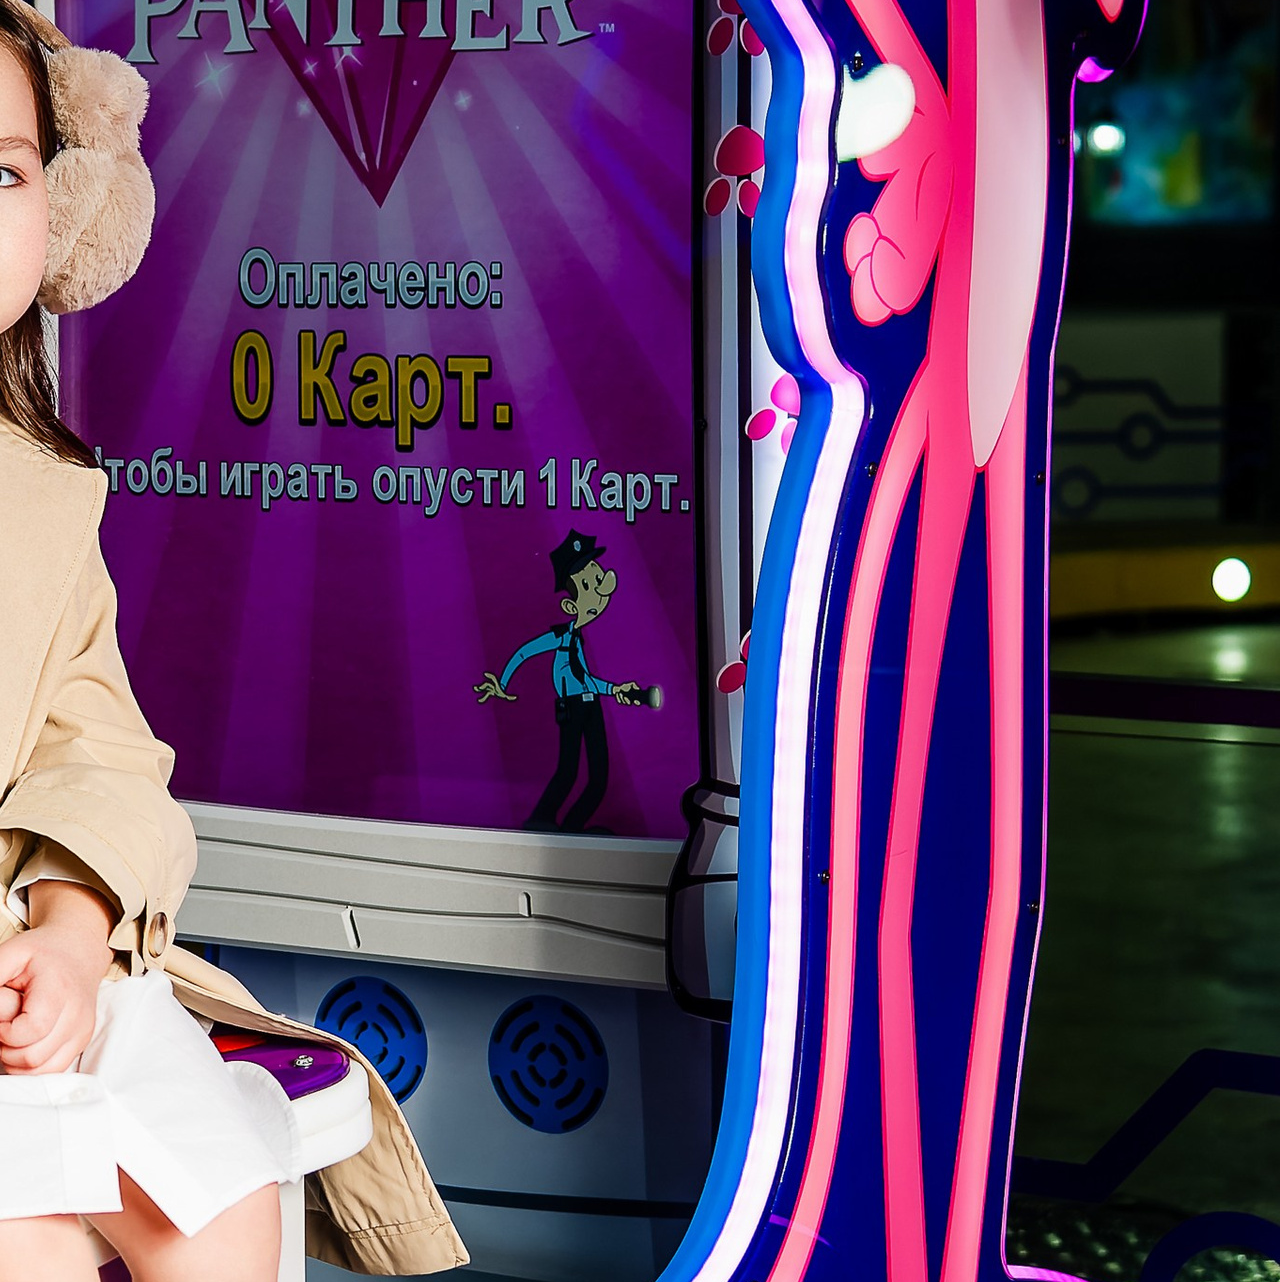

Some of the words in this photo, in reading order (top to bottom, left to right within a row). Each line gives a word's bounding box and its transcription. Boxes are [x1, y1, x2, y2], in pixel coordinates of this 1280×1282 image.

[237, 246, 505, 309] Оплачено:
[296, 327, 513, 452] Карт.
[93, 445, 208, 496] тобы
[219, 456, 358, 511] играть
[371, 462, 526, 517] опусти
[537, 456, 558, 508] 1
[569, 457, 692, 524] Карт.
